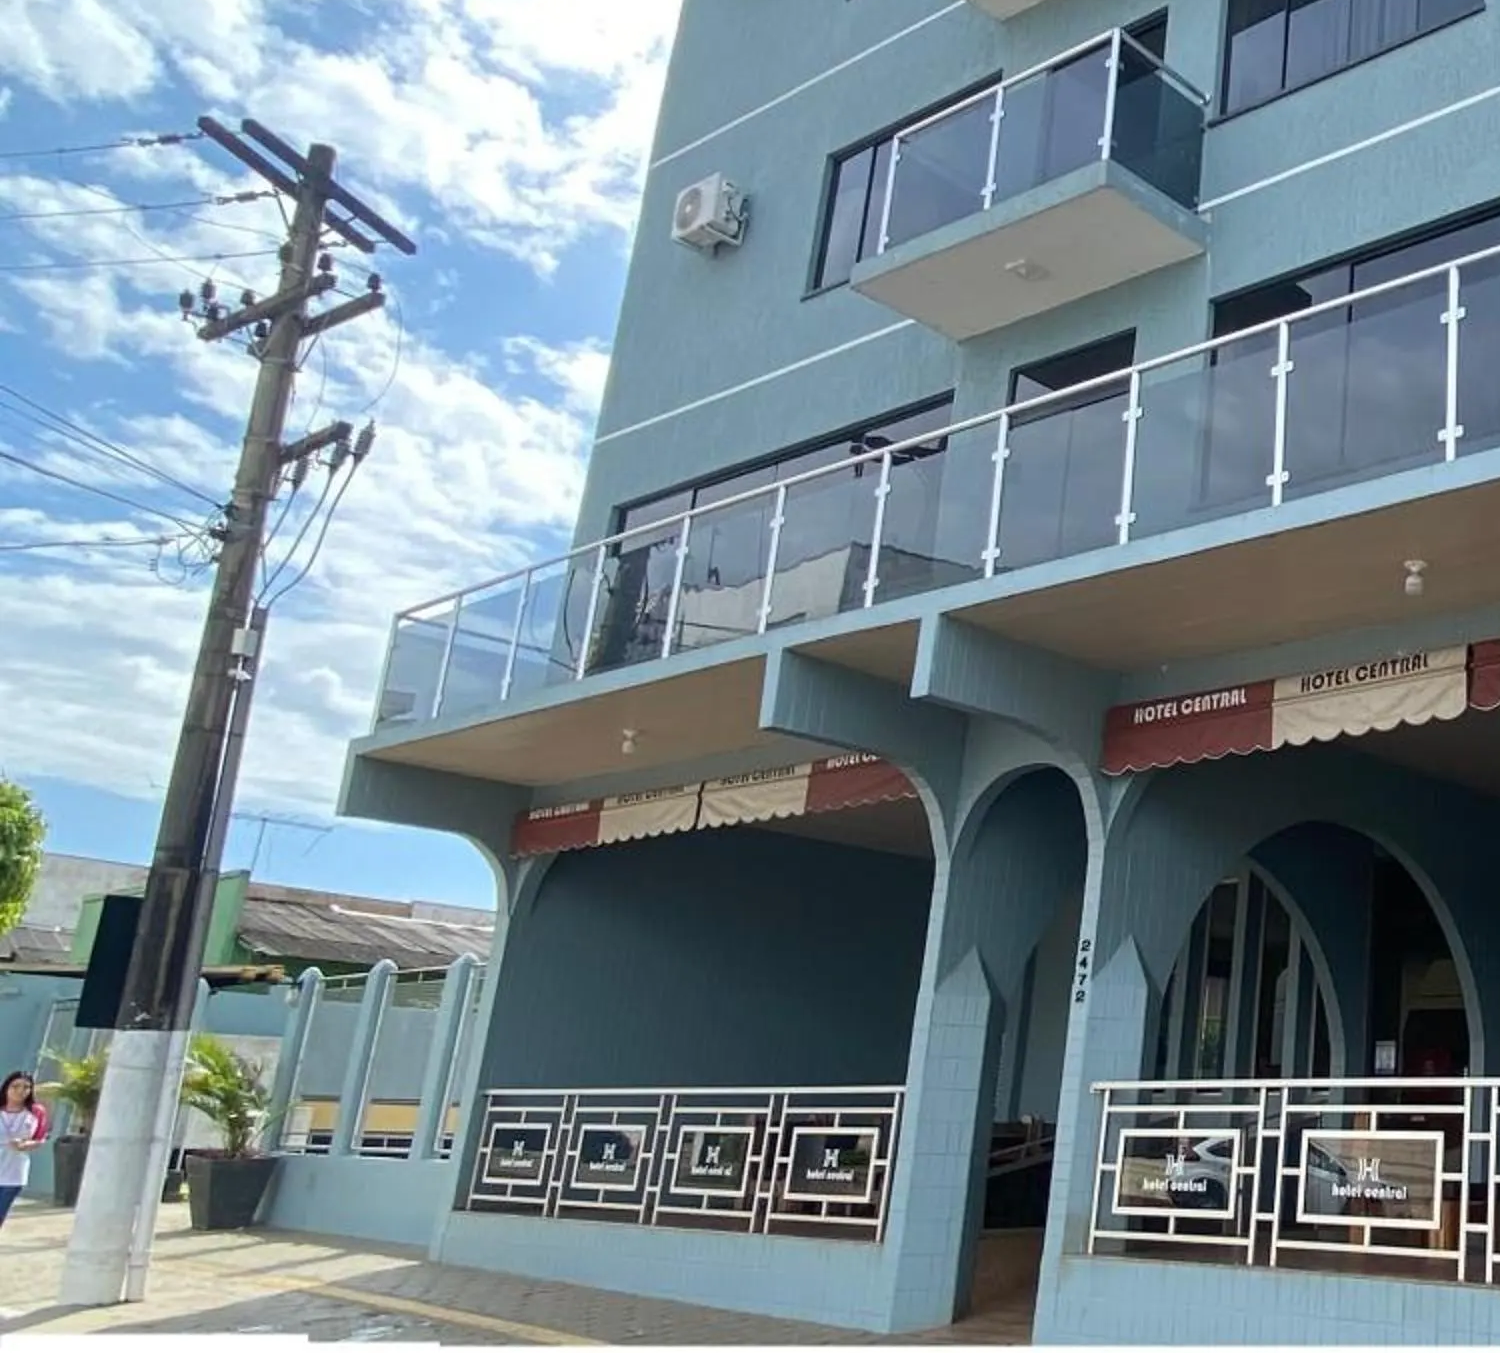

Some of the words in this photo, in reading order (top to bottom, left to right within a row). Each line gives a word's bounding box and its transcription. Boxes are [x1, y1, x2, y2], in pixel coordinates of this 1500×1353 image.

[1301, 669, 1350, 692] HOTEL
[1355, 653, 1429, 682] CENTRAL
[1133, 700, 1177, 724] HOTEL
[1181, 687, 1247, 714] CENTRAL
[1075, 939, 1091, 1003] 2472
[1143, 1179, 1168, 1192] hotel
[1169, 1179, 1207, 1192] central
[1332, 1185, 1363, 1197] hotel
[1365, 1186, 1407, 1200] central
